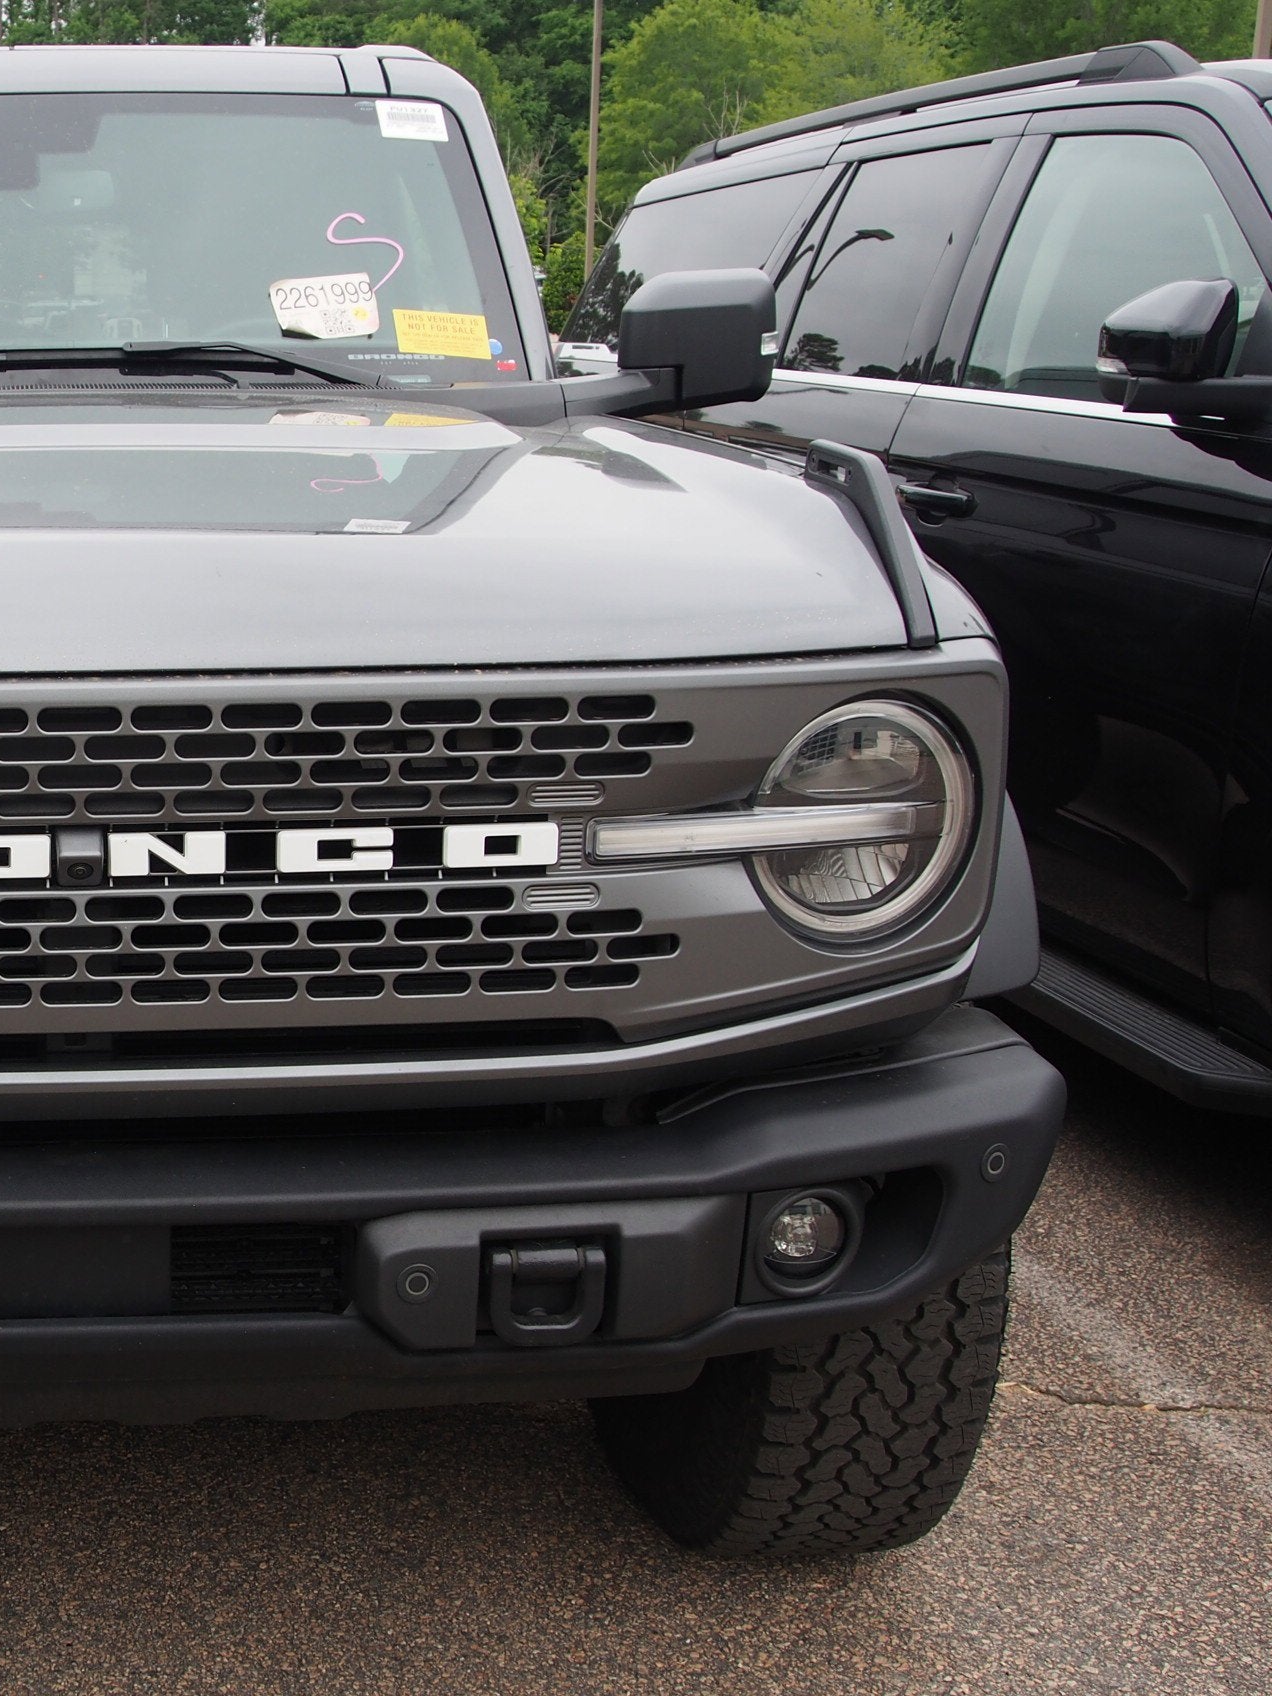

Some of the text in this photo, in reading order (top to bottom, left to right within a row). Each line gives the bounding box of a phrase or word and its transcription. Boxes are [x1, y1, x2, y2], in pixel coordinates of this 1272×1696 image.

[275, 280, 373, 311] 2261999
[402, 313, 479, 326] THIS VEHICLE IS
[408, 323, 476, 335] NOT FOR SALE
